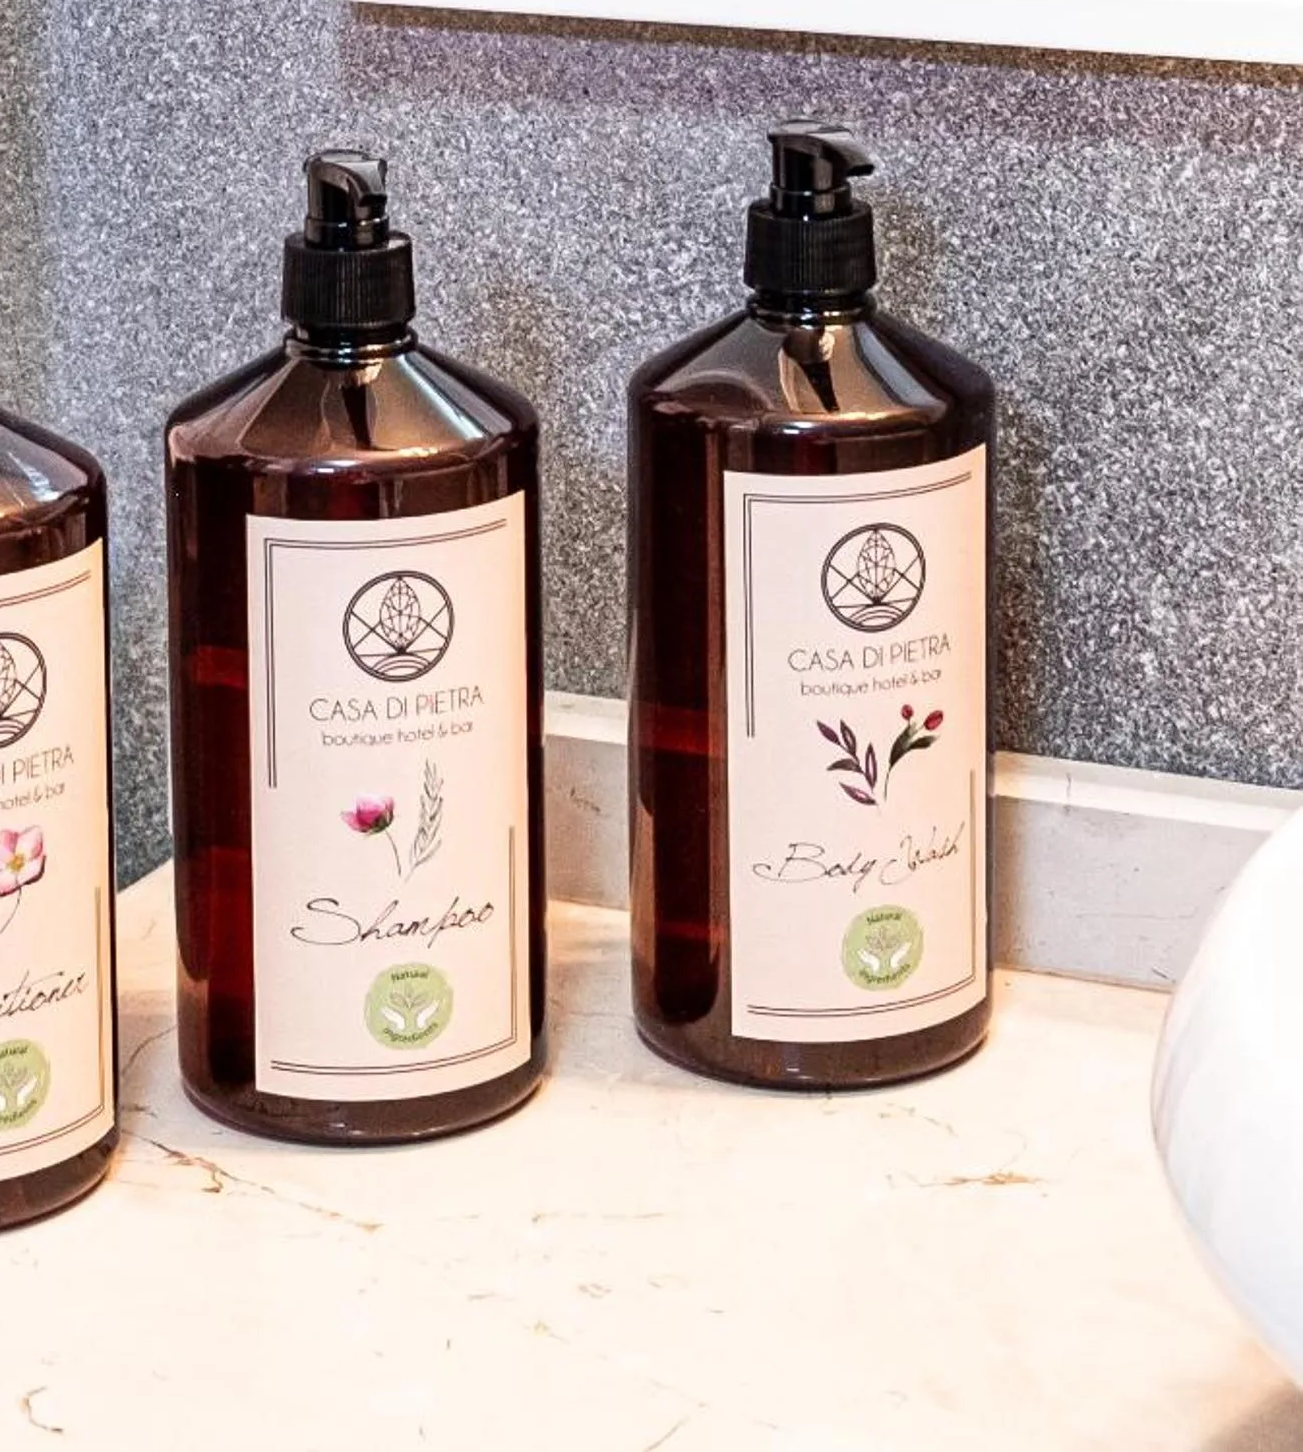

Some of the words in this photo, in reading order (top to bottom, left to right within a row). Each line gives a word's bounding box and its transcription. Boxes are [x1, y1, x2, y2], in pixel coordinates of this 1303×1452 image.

[787, 648, 855, 672] CASA
[863, 646, 884, 669] DI
[890, 633, 952, 664] PIETRA
[800, 680, 869, 697] boutique
[872, 674, 908, 692] hotel
[909, 670, 918, 685] &
[921, 668, 942, 683] bar
[309, 698, 378, 722] CASA
[386, 696, 408, 720] DI
[415, 685, 485, 716] PIETRA
[321, 731, 393, 747] boutique
[397, 724, 434, 743] hotel
[437, 722, 448, 738] &
[451, 720, 474, 736] bar
[13, 743, 75, 784] PIETRA
[33, 783, 43, 803] &
[46, 781, 66, 800] bar
[752, 842, 877, 893] Body
[879, 820, 965, 885] Wash
[289, 896, 495, 949] Shampoo
[866, 912, 903, 926] Natural
[391, 969, 430, 984] Natural
